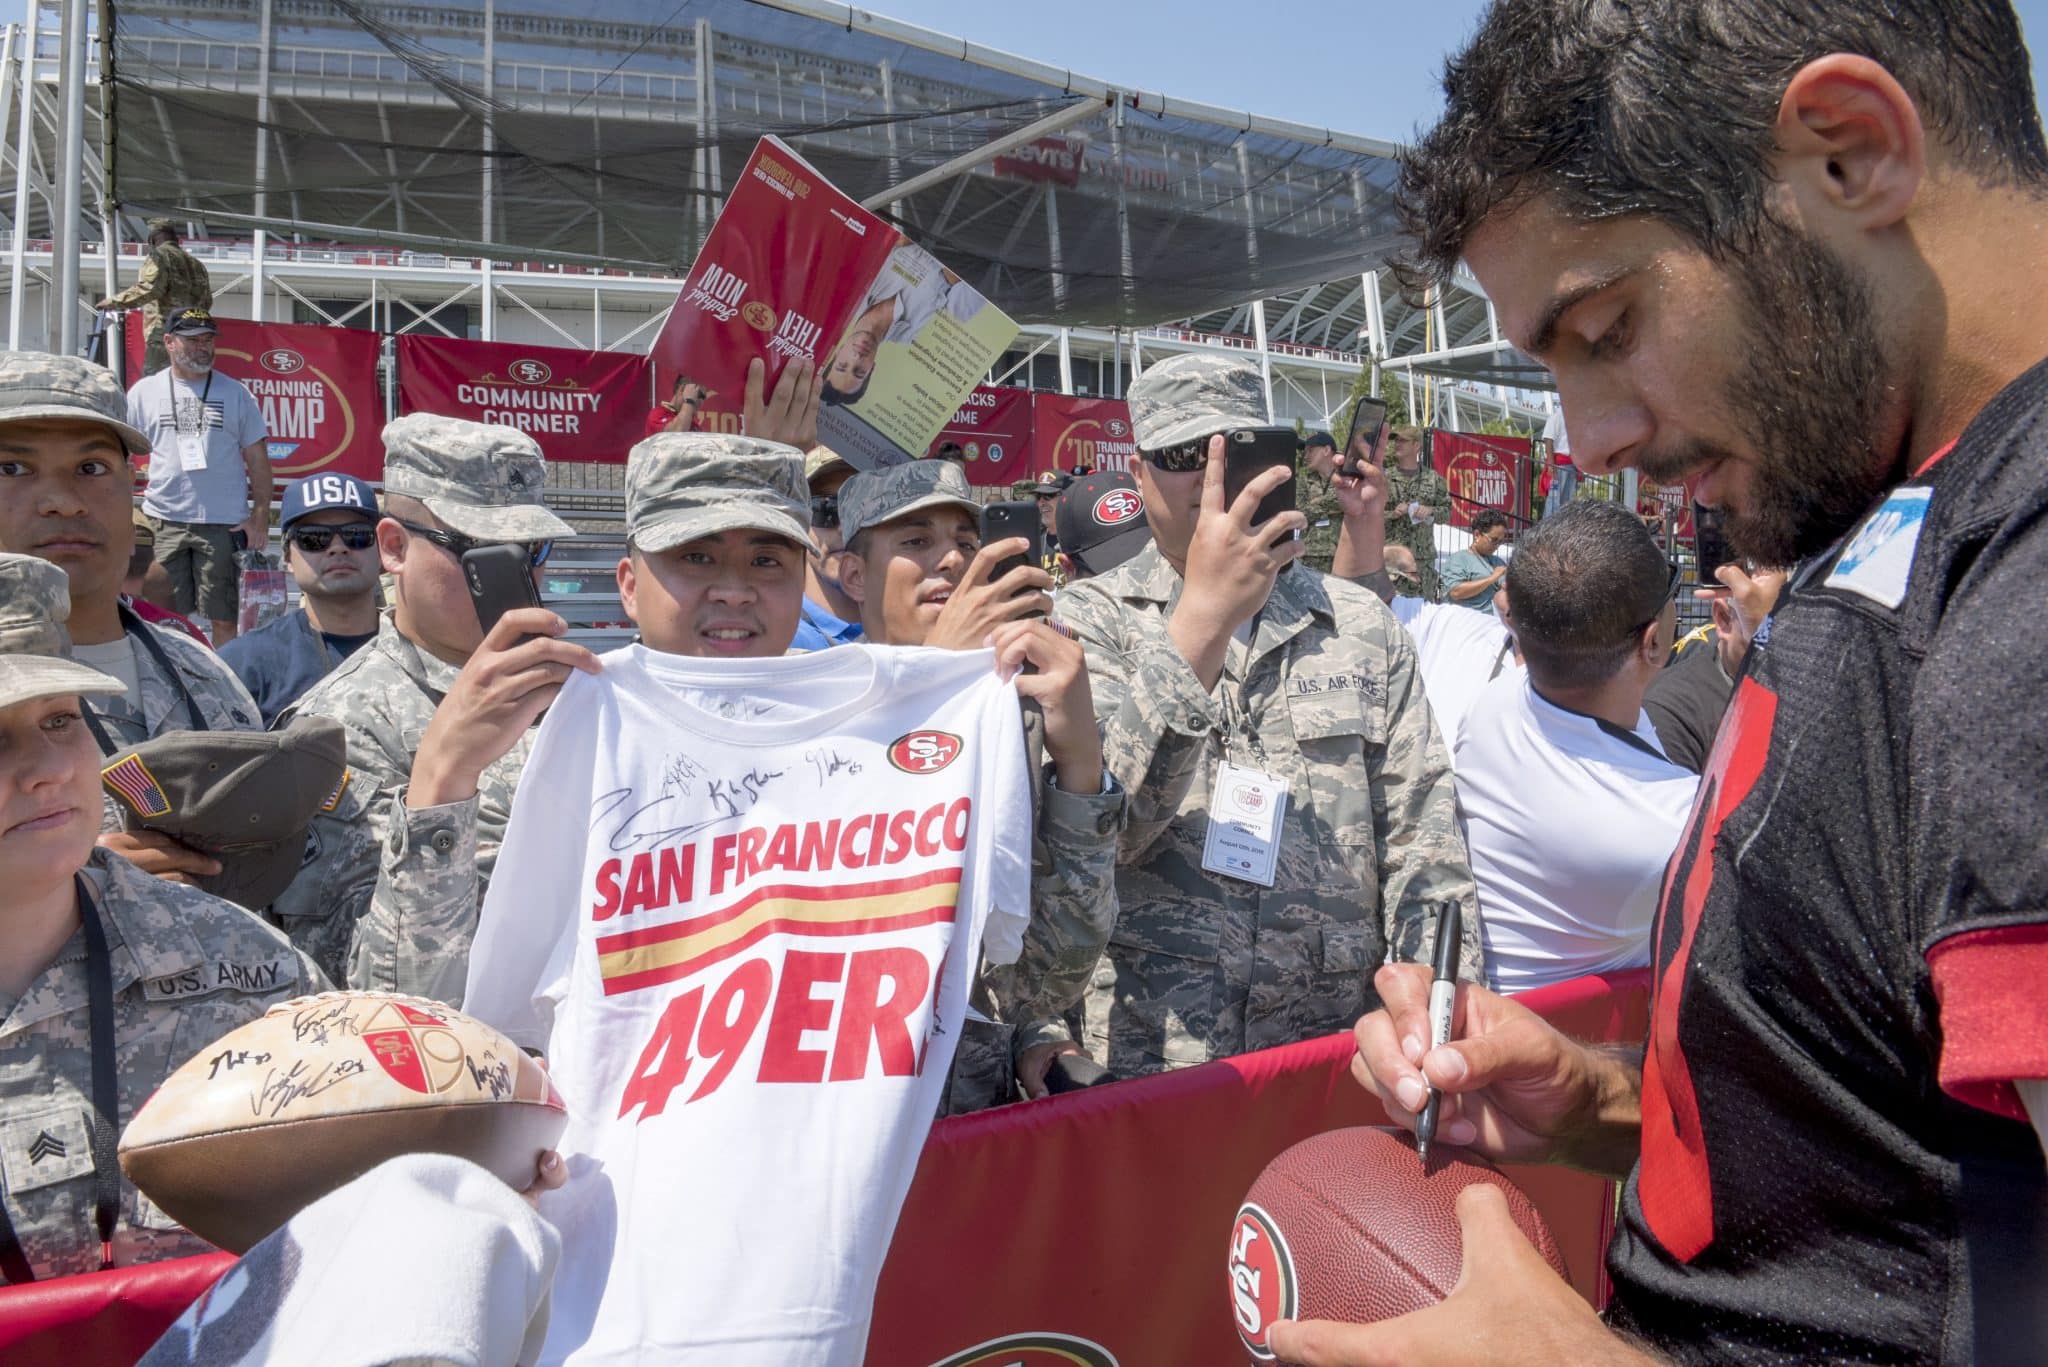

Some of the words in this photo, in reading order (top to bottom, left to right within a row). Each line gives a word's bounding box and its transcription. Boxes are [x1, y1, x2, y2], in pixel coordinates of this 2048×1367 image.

[698, 263, 749, 307] NOW
[684, 288, 739, 322] Faithful
[778, 309, 822, 353] THEN
[521, 363, 543, 381] SF
[241, 378, 324, 398] TRAINING
[457, 384, 602, 412] COMMUNITY
[261, 396, 325, 439] AMP
[483, 409, 580, 434] CORNER
[1096, 453, 1131, 472] CAM
[1475, 468, 1506, 480] TRAINING
[302, 476, 362, 508] USA
[1105, 493, 1137, 518] SF
[1476, 479, 1507, 505] CAMP
[1298, 680, 1322, 694] U.S.
[1327, 675, 1350, 690] AIR
[1351, 675, 1379, 696] FORCE
[908, 735, 952, 770] SF
[592, 843, 697, 921] SAN
[709, 796, 972, 895] FRANCISCO
[158, 970, 207, 995] U.S.
[218, 962, 279, 989] ARMY
[373, 1036, 413, 1067] SF
[1230, 1222, 1261, 1335] SF
